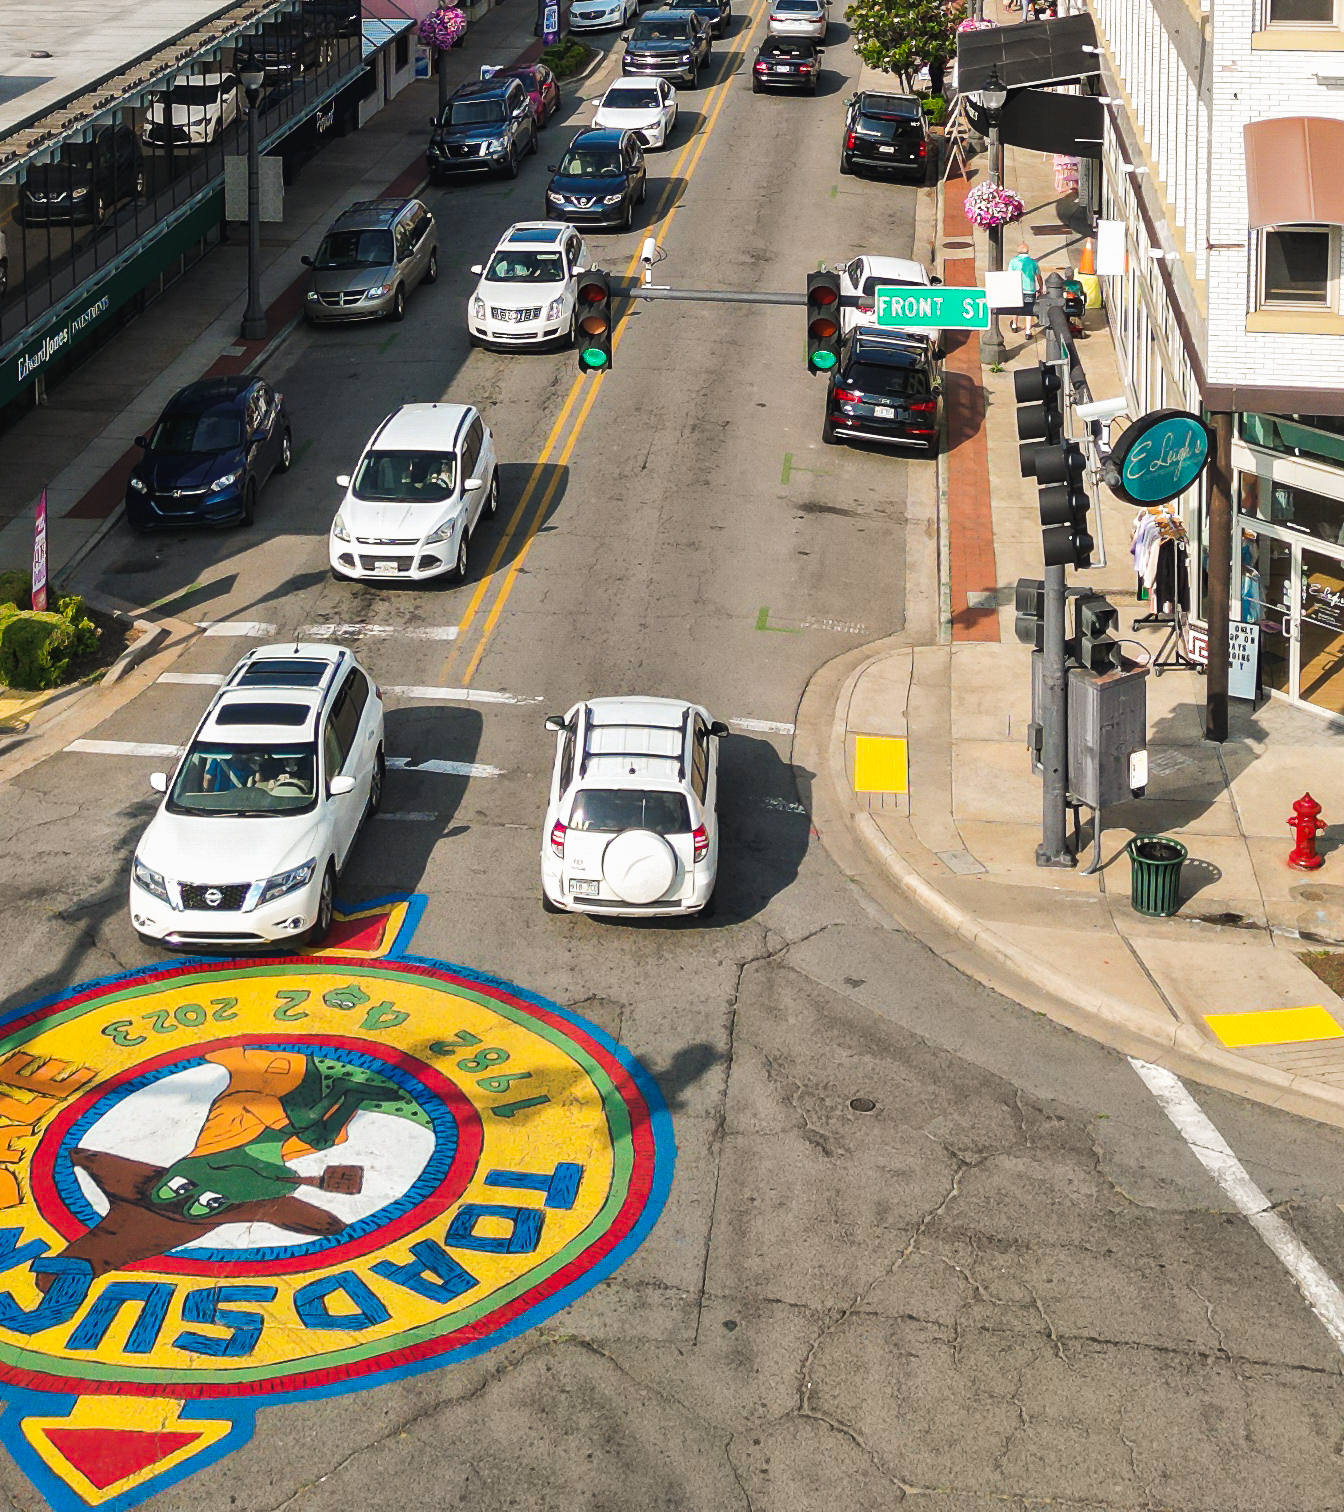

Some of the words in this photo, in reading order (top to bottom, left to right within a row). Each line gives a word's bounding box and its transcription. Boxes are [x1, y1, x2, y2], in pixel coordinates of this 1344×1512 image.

[878, 295, 944, 319] FRONT
[962, 297, 987, 320] ST
[101, 996, 239, 1047] 2023
[428, 1029, 552, 1119] 1982
[291, 1161, 583, 1333] TOAD
